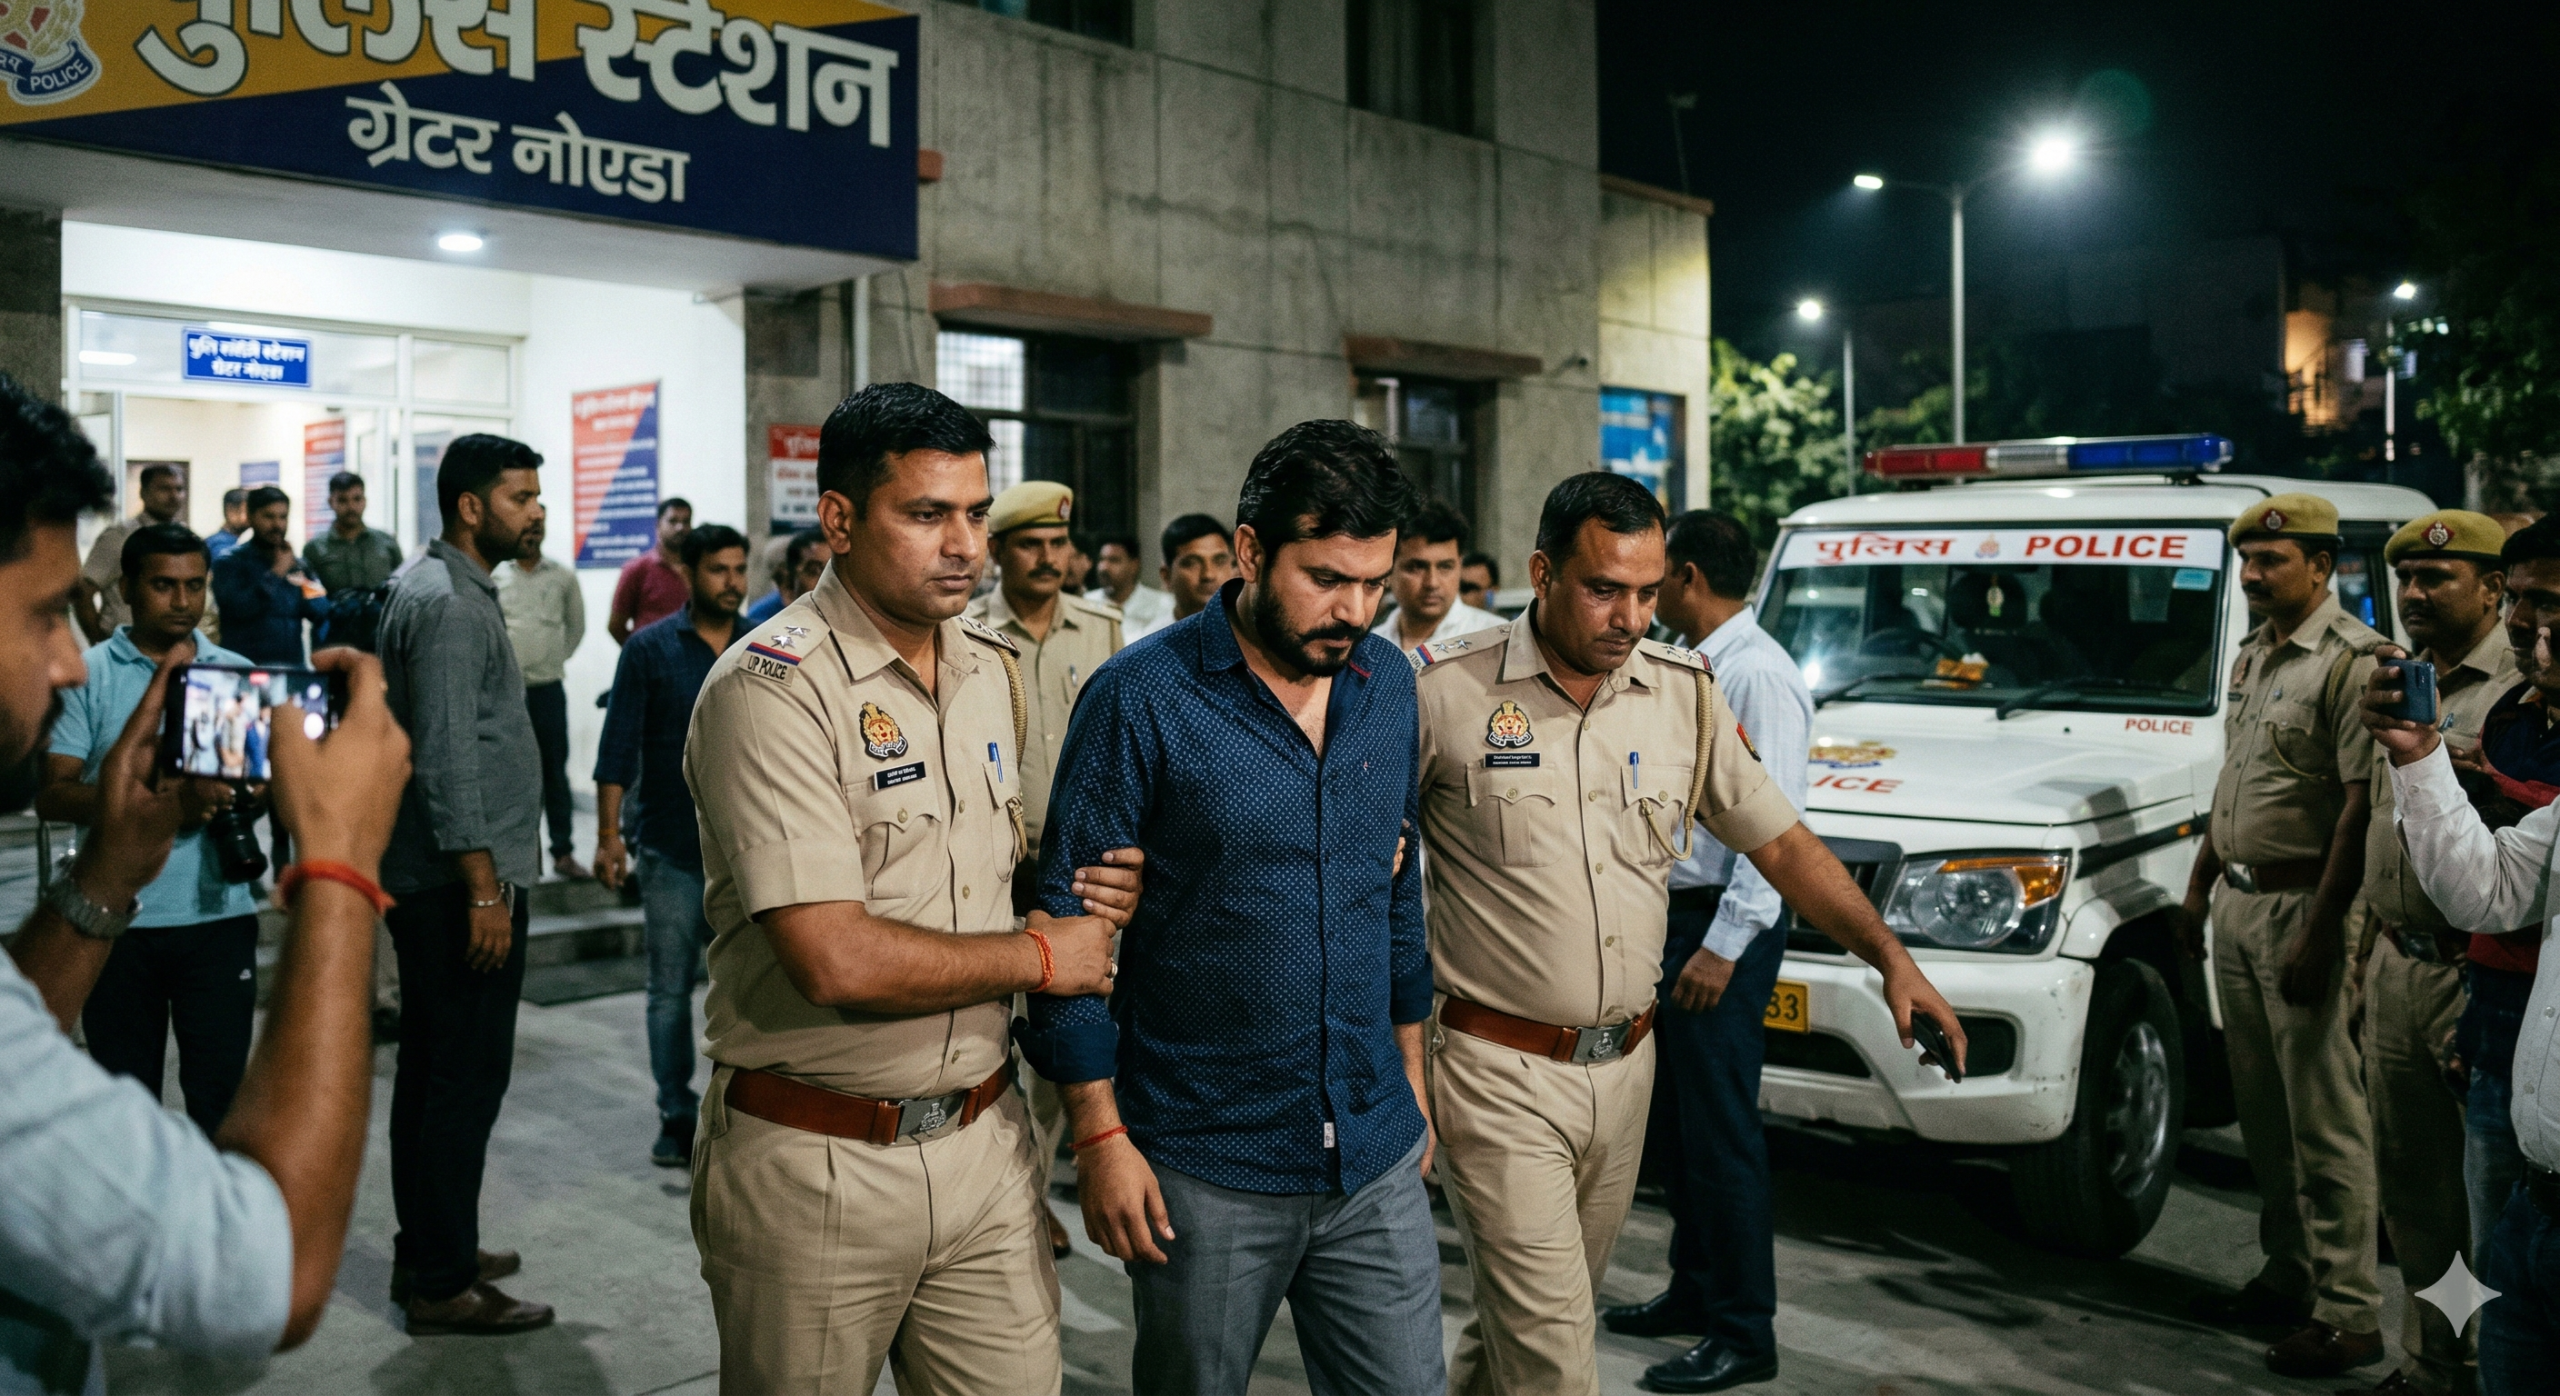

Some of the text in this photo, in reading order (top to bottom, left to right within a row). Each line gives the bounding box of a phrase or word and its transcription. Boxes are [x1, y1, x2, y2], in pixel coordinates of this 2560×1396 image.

[30, 59, 89, 92] POLICE
[346, 80, 690, 203] ग्रेटर नोएडा
[1815, 531, 1957, 565] पुलिस
[2024, 535, 2188, 559] POLICE
[747, 655, 788, 680] UP POLICE
[2124, 718, 2194, 736] POLICE
